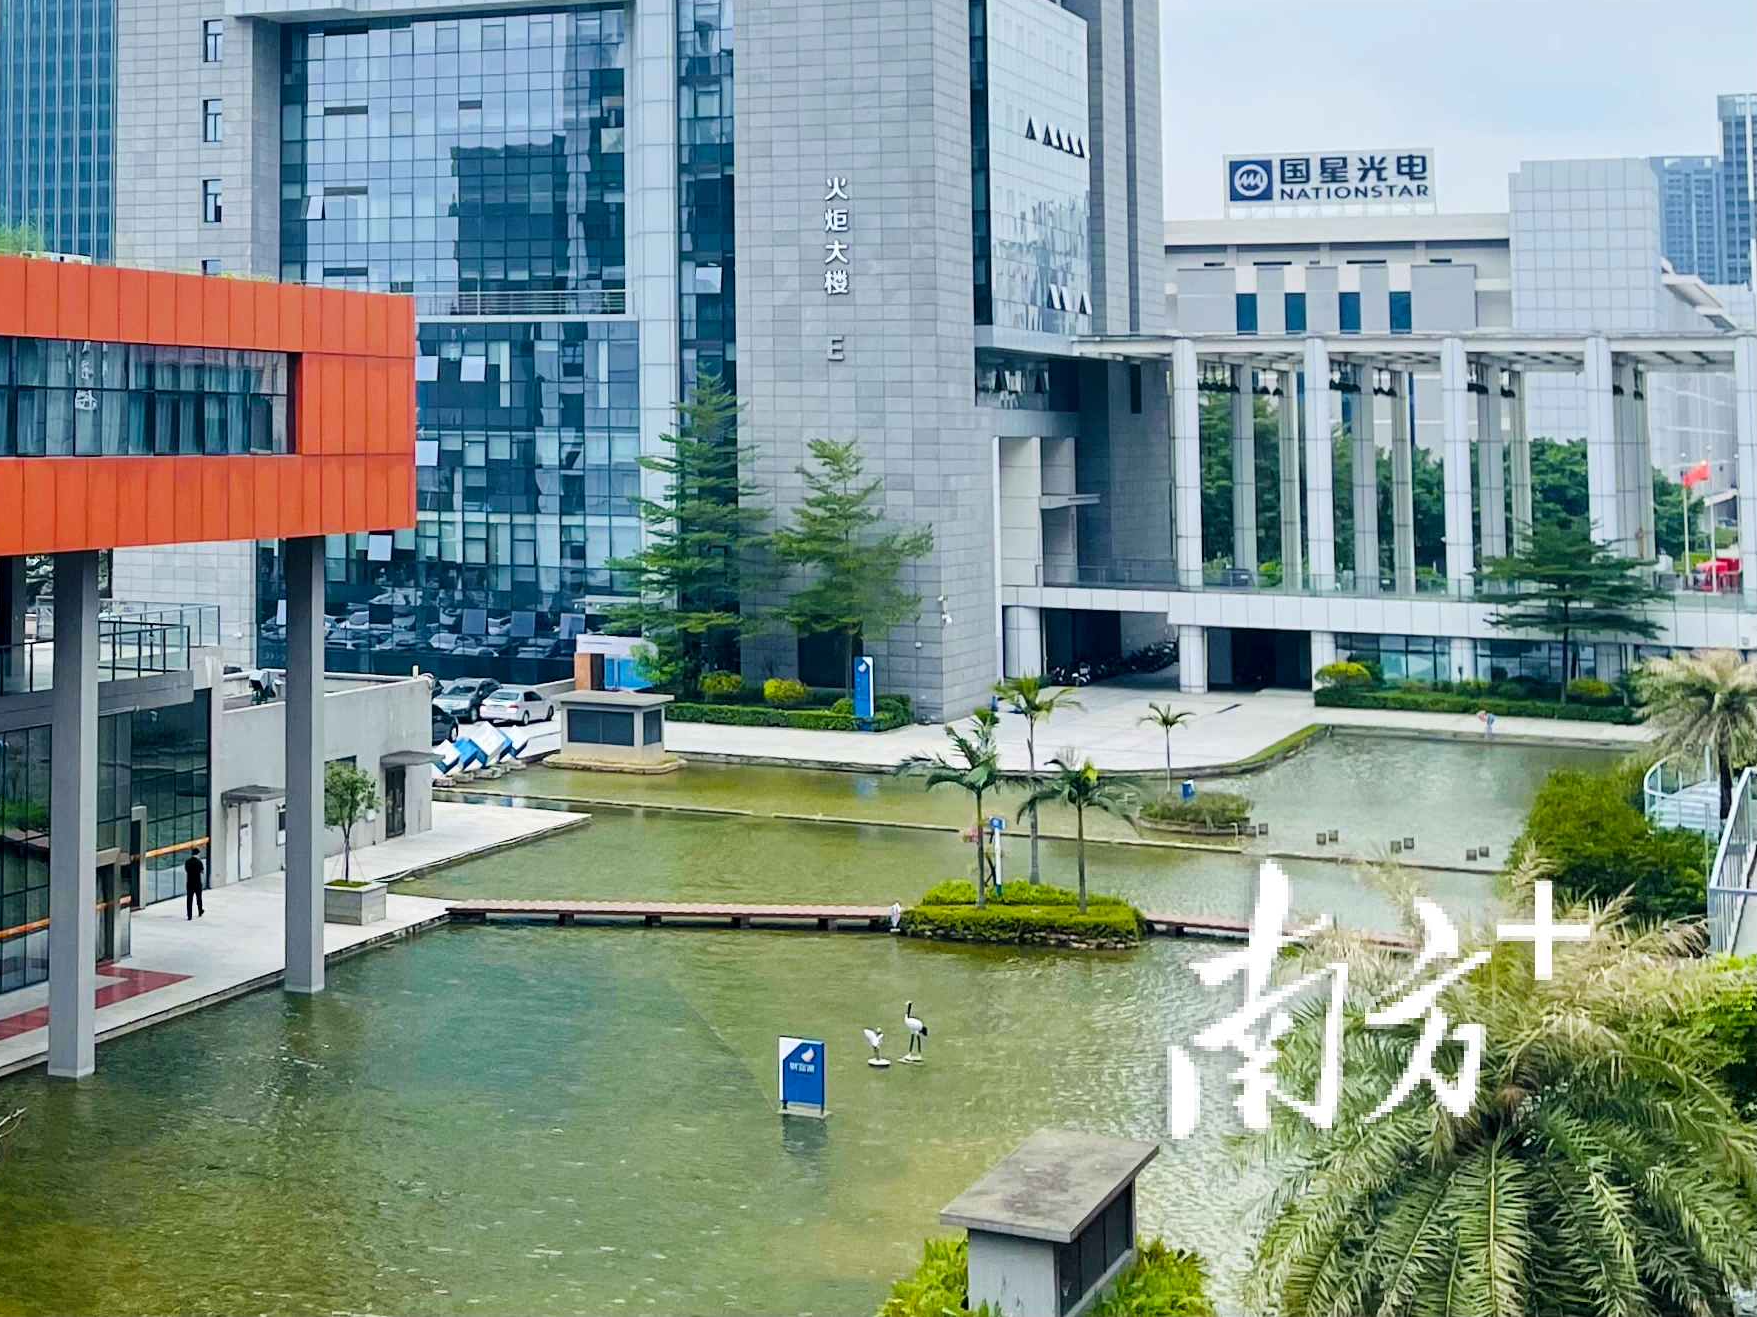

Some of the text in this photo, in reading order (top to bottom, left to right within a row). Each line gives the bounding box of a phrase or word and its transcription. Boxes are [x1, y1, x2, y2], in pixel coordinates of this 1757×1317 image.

[1280, 154, 1428, 184] 国星光电
[1280, 184, 1429, 201] NATIONSTAR
[824, 176, 849, 295] 火炬大楼
[827, 335, 845, 361] E
